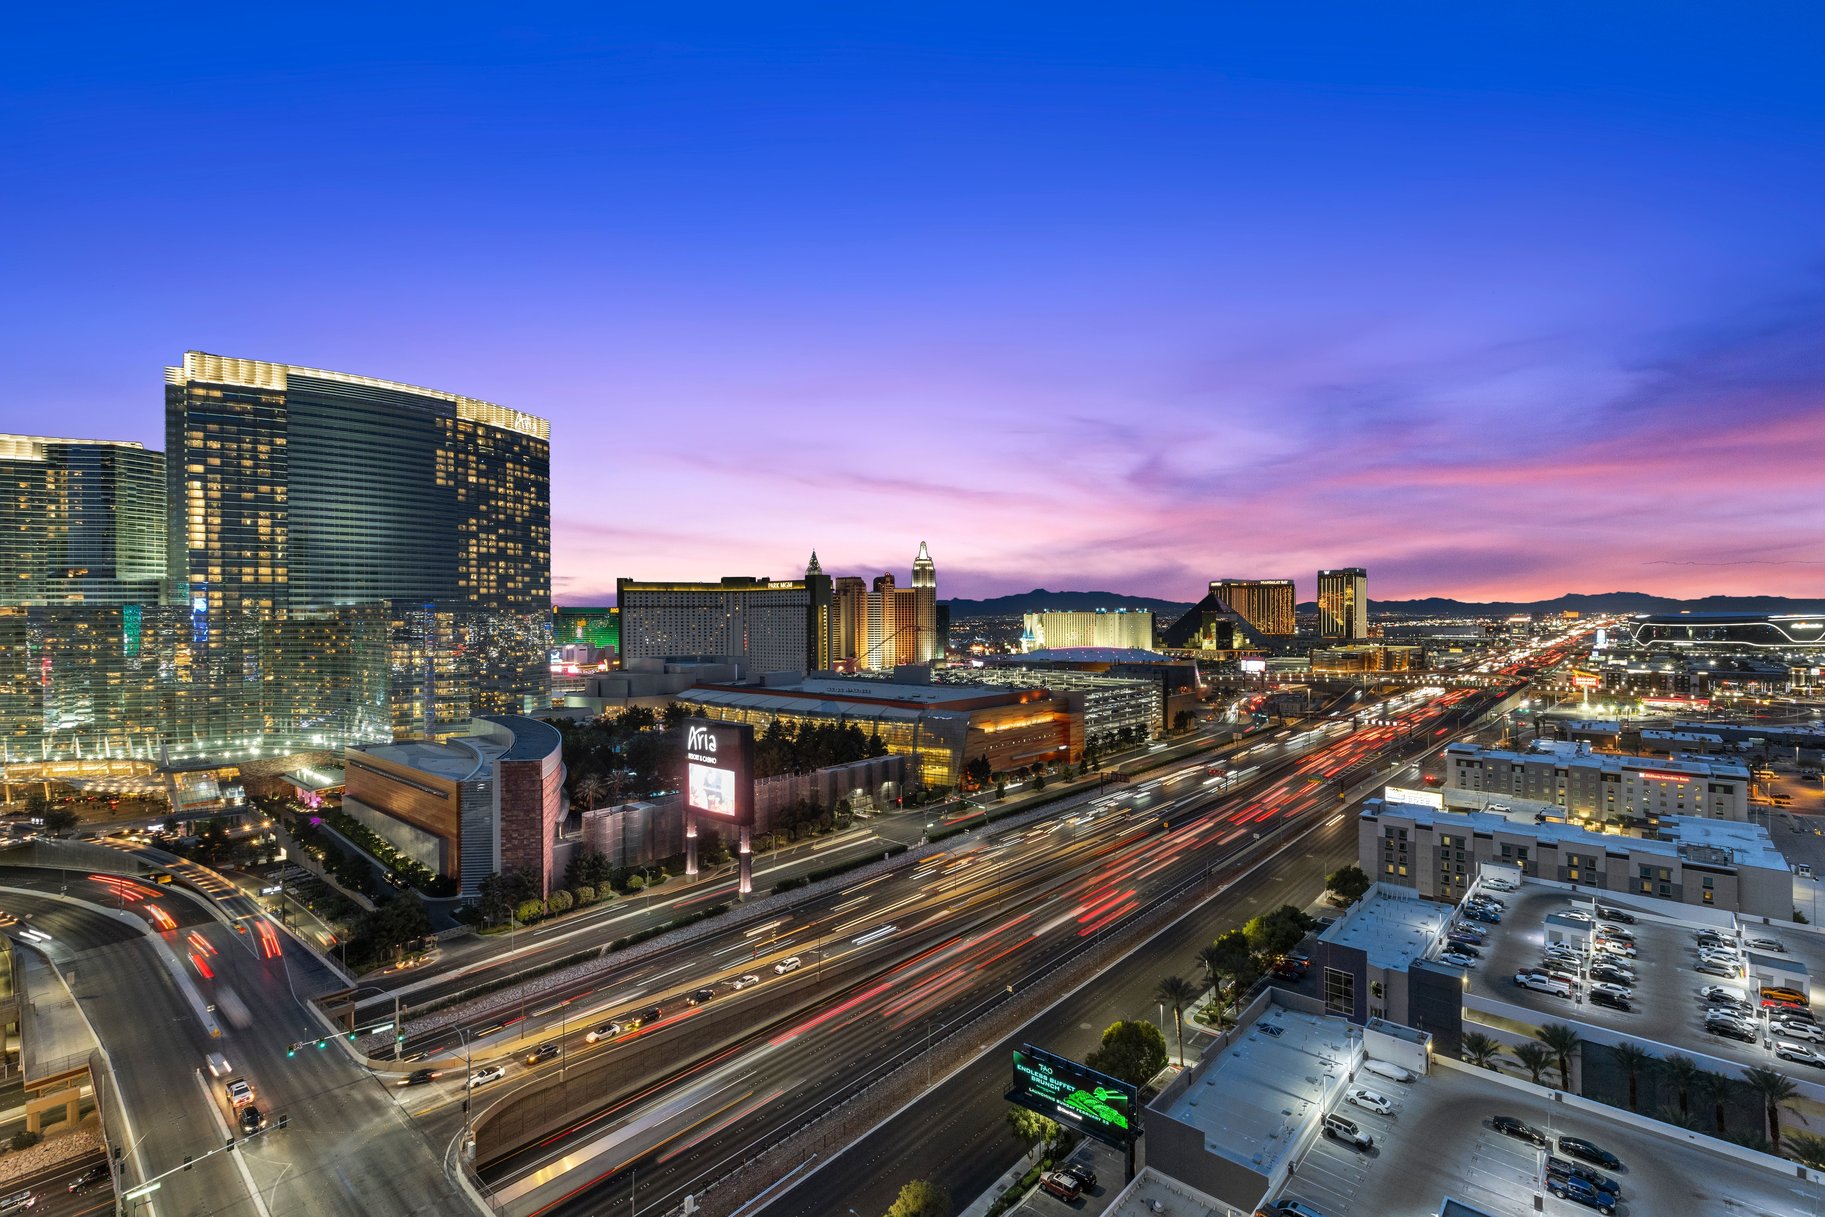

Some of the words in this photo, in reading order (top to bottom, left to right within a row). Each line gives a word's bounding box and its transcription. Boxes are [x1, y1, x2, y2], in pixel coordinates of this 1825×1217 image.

[687, 725, 717, 752] Aria
[1016, 1064, 1048, 1081] ENDLESS
[1049, 1077, 1076, 1092] BUFFET
[1038, 1063, 1053, 1075] TAO
[1031, 1075, 1060, 1091] BRUNCH
[1029, 1087, 1056, 1101] LAUNCHING
[1056, 1099, 1075, 1110] SUNDAY
[1076, 1108, 1102, 1121] FEBRUARY
